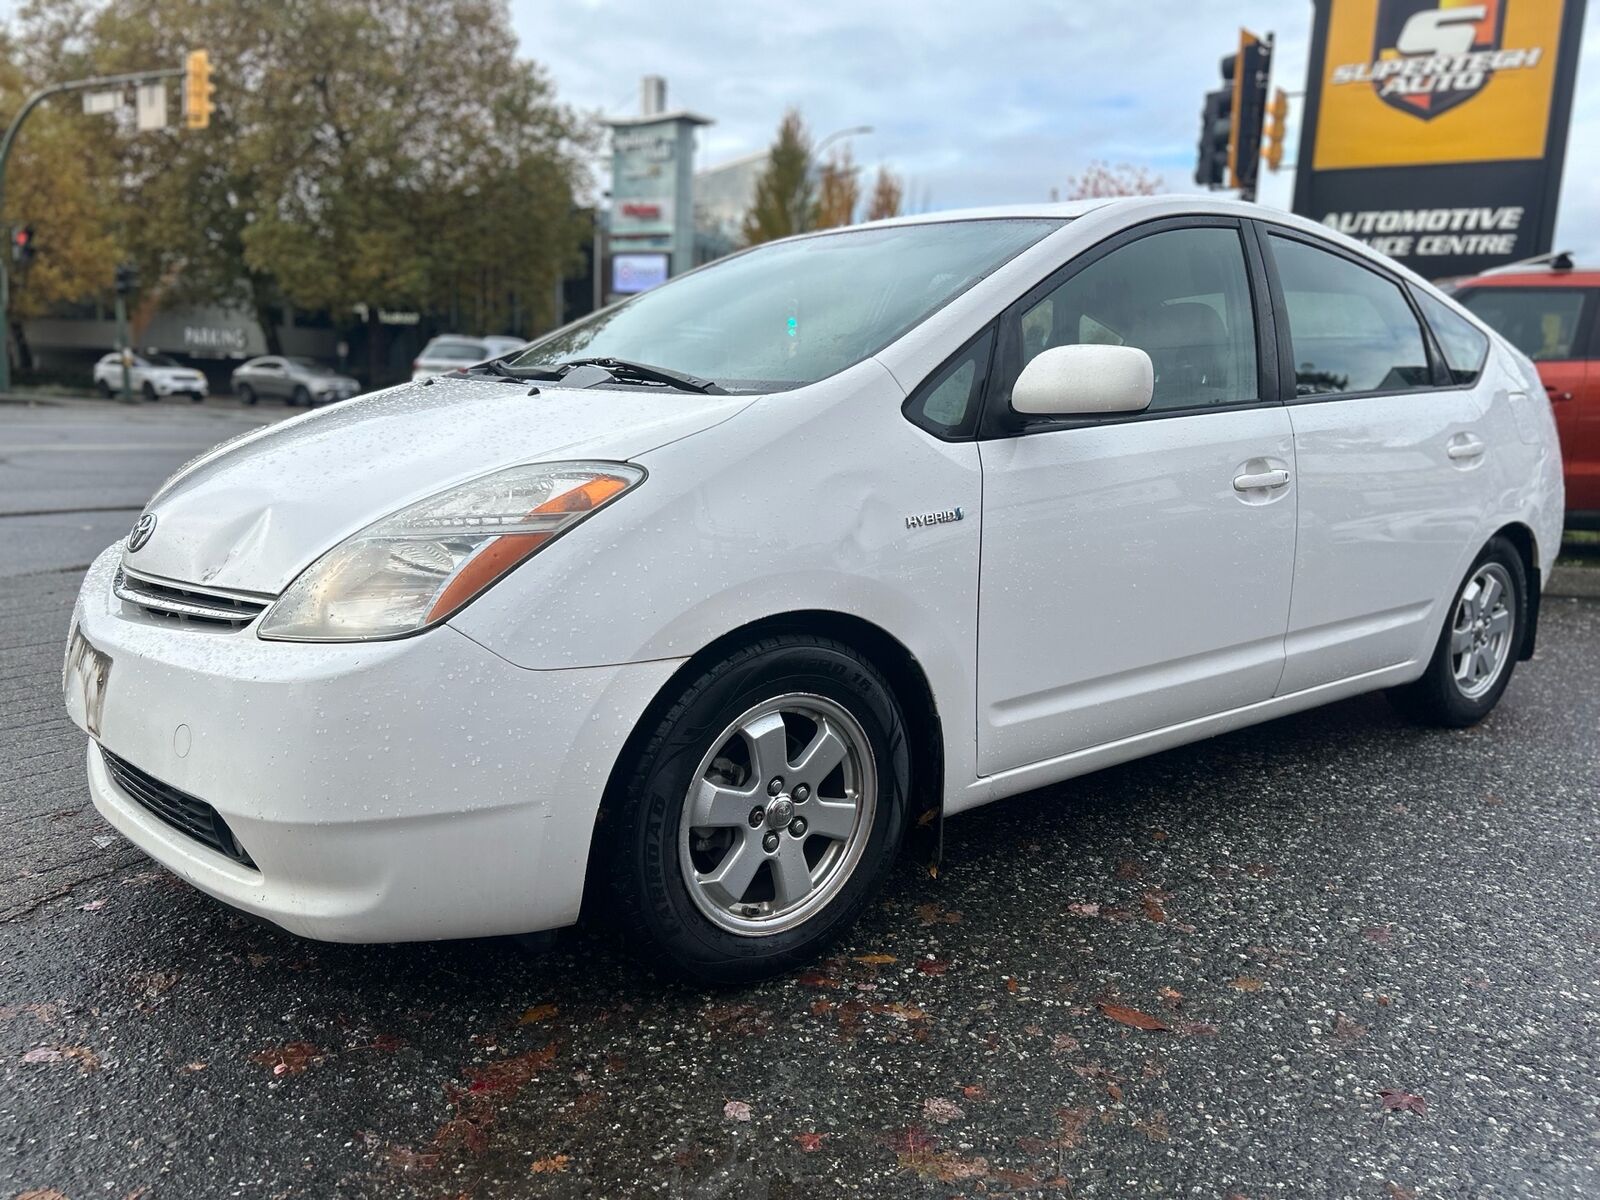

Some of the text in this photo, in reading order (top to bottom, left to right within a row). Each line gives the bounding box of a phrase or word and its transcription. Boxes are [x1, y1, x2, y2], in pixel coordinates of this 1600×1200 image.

[1333, 47, 1542, 83] SUPERTECH
[1381, 73, 1484, 96] AUTO
[1320, 206, 1524, 235] AUTOMOTIVE
[1416, 234, 1517, 255] CENTRE
[184, 326, 246, 350] PARKING
[904, 509, 957, 529] HYBRID
